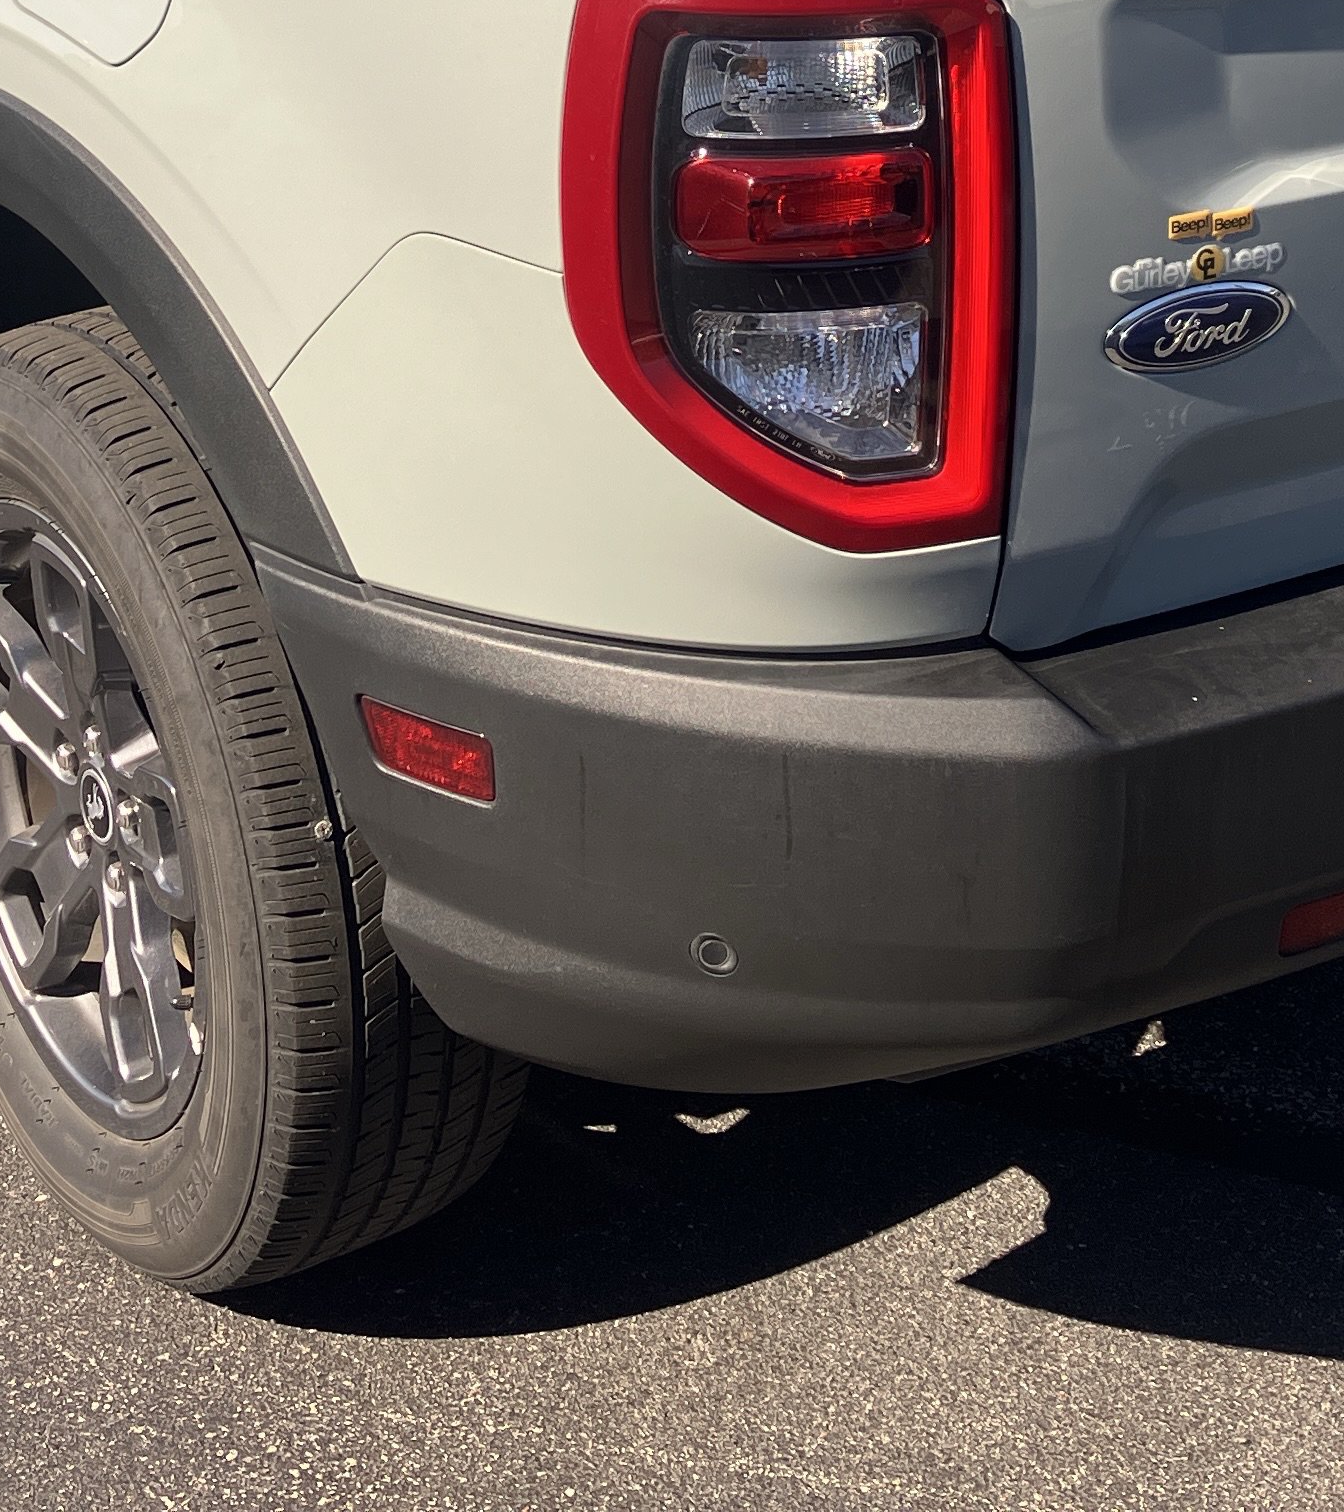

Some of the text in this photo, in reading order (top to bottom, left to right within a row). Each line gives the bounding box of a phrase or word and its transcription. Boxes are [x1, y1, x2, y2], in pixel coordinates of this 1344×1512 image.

[1171, 213, 1251, 234] Beep! Beep!
[1110, 257, 1193, 294] Gurley
[1223, 242, 1285, 273] Leep
[1154, 303, 1253, 358] Ford
